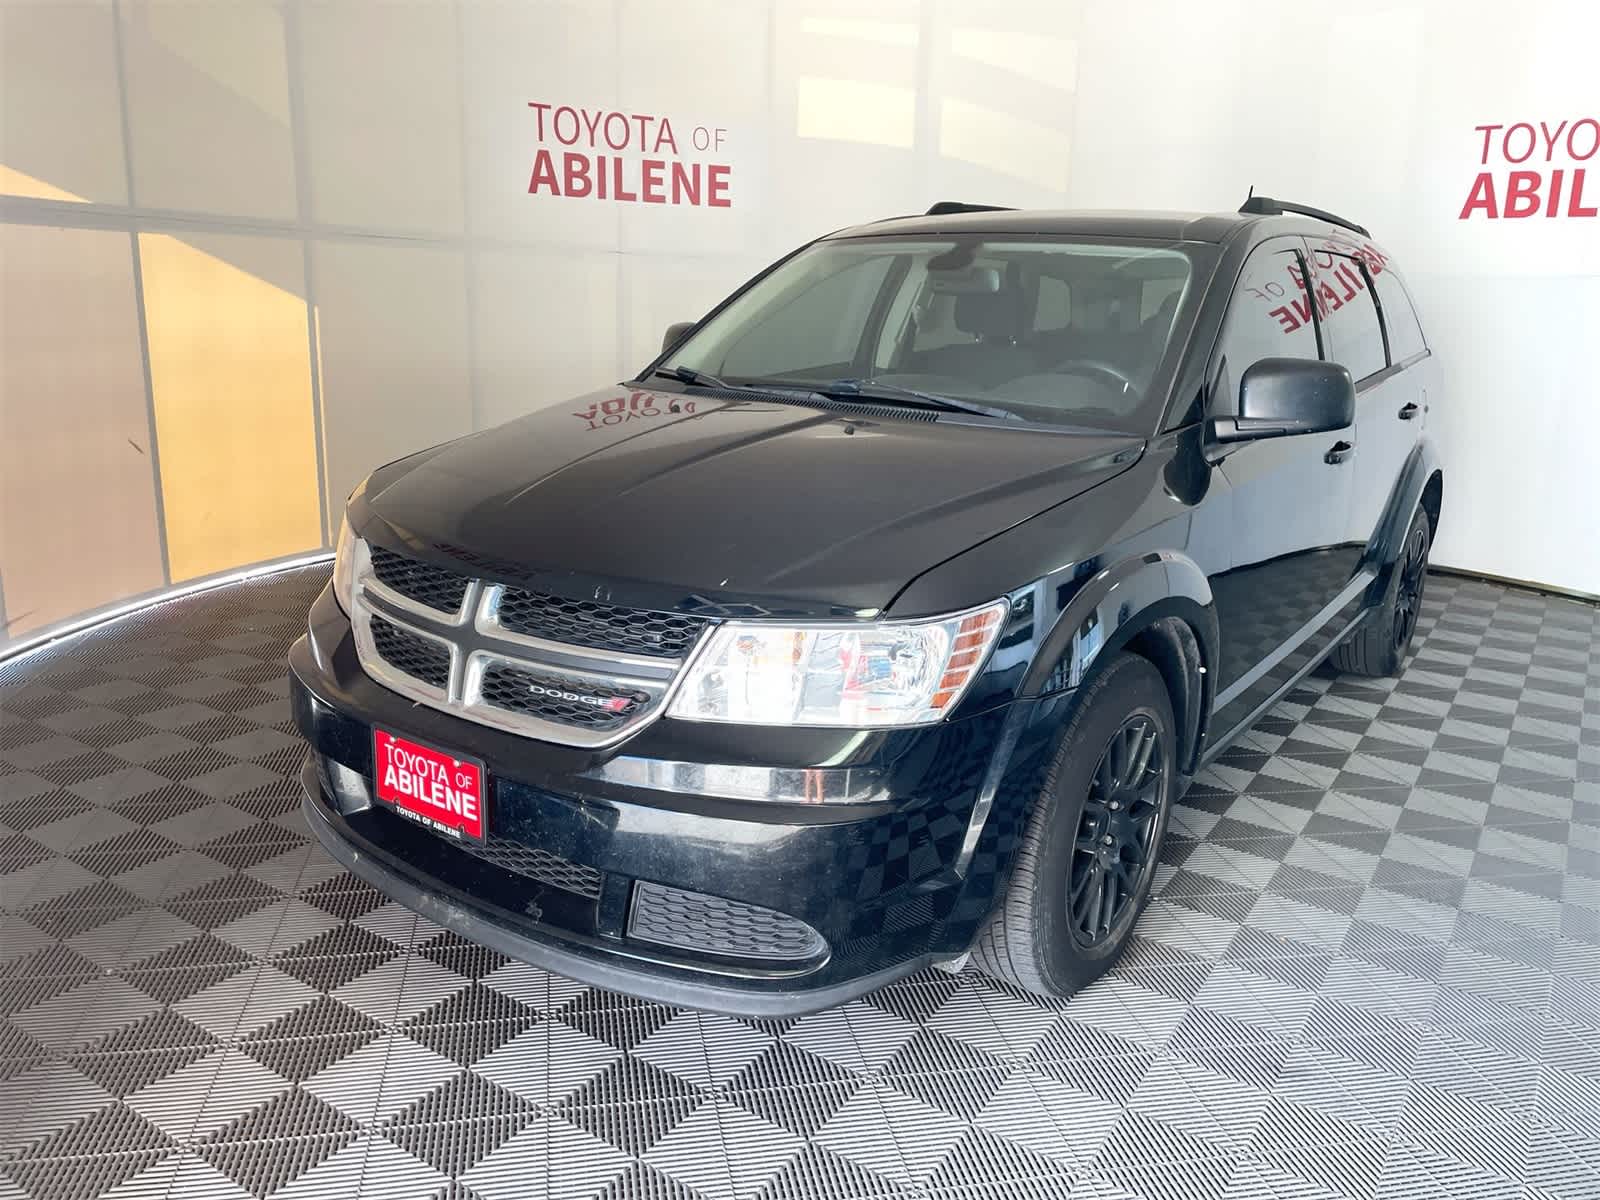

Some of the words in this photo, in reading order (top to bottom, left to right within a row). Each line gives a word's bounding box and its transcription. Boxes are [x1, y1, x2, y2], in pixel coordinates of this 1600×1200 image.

[528, 102, 678, 154] TOYOTA
[692, 126, 727, 152] OF
[1475, 118, 1600, 165] TOYO
[528, 149, 731, 207] ABILENE
[1458, 168, 1598, 219] ABIL
[530, 685, 612, 706] DODGE
[384, 743, 450, 786] TOYOTA
[455, 772, 473, 789] OF
[384, 764, 478, 821] ABILENE
[396, 806, 420, 822] TOYOTA
[422, 816, 432, 826] OF
[433, 821, 461, 838] ABILENE
